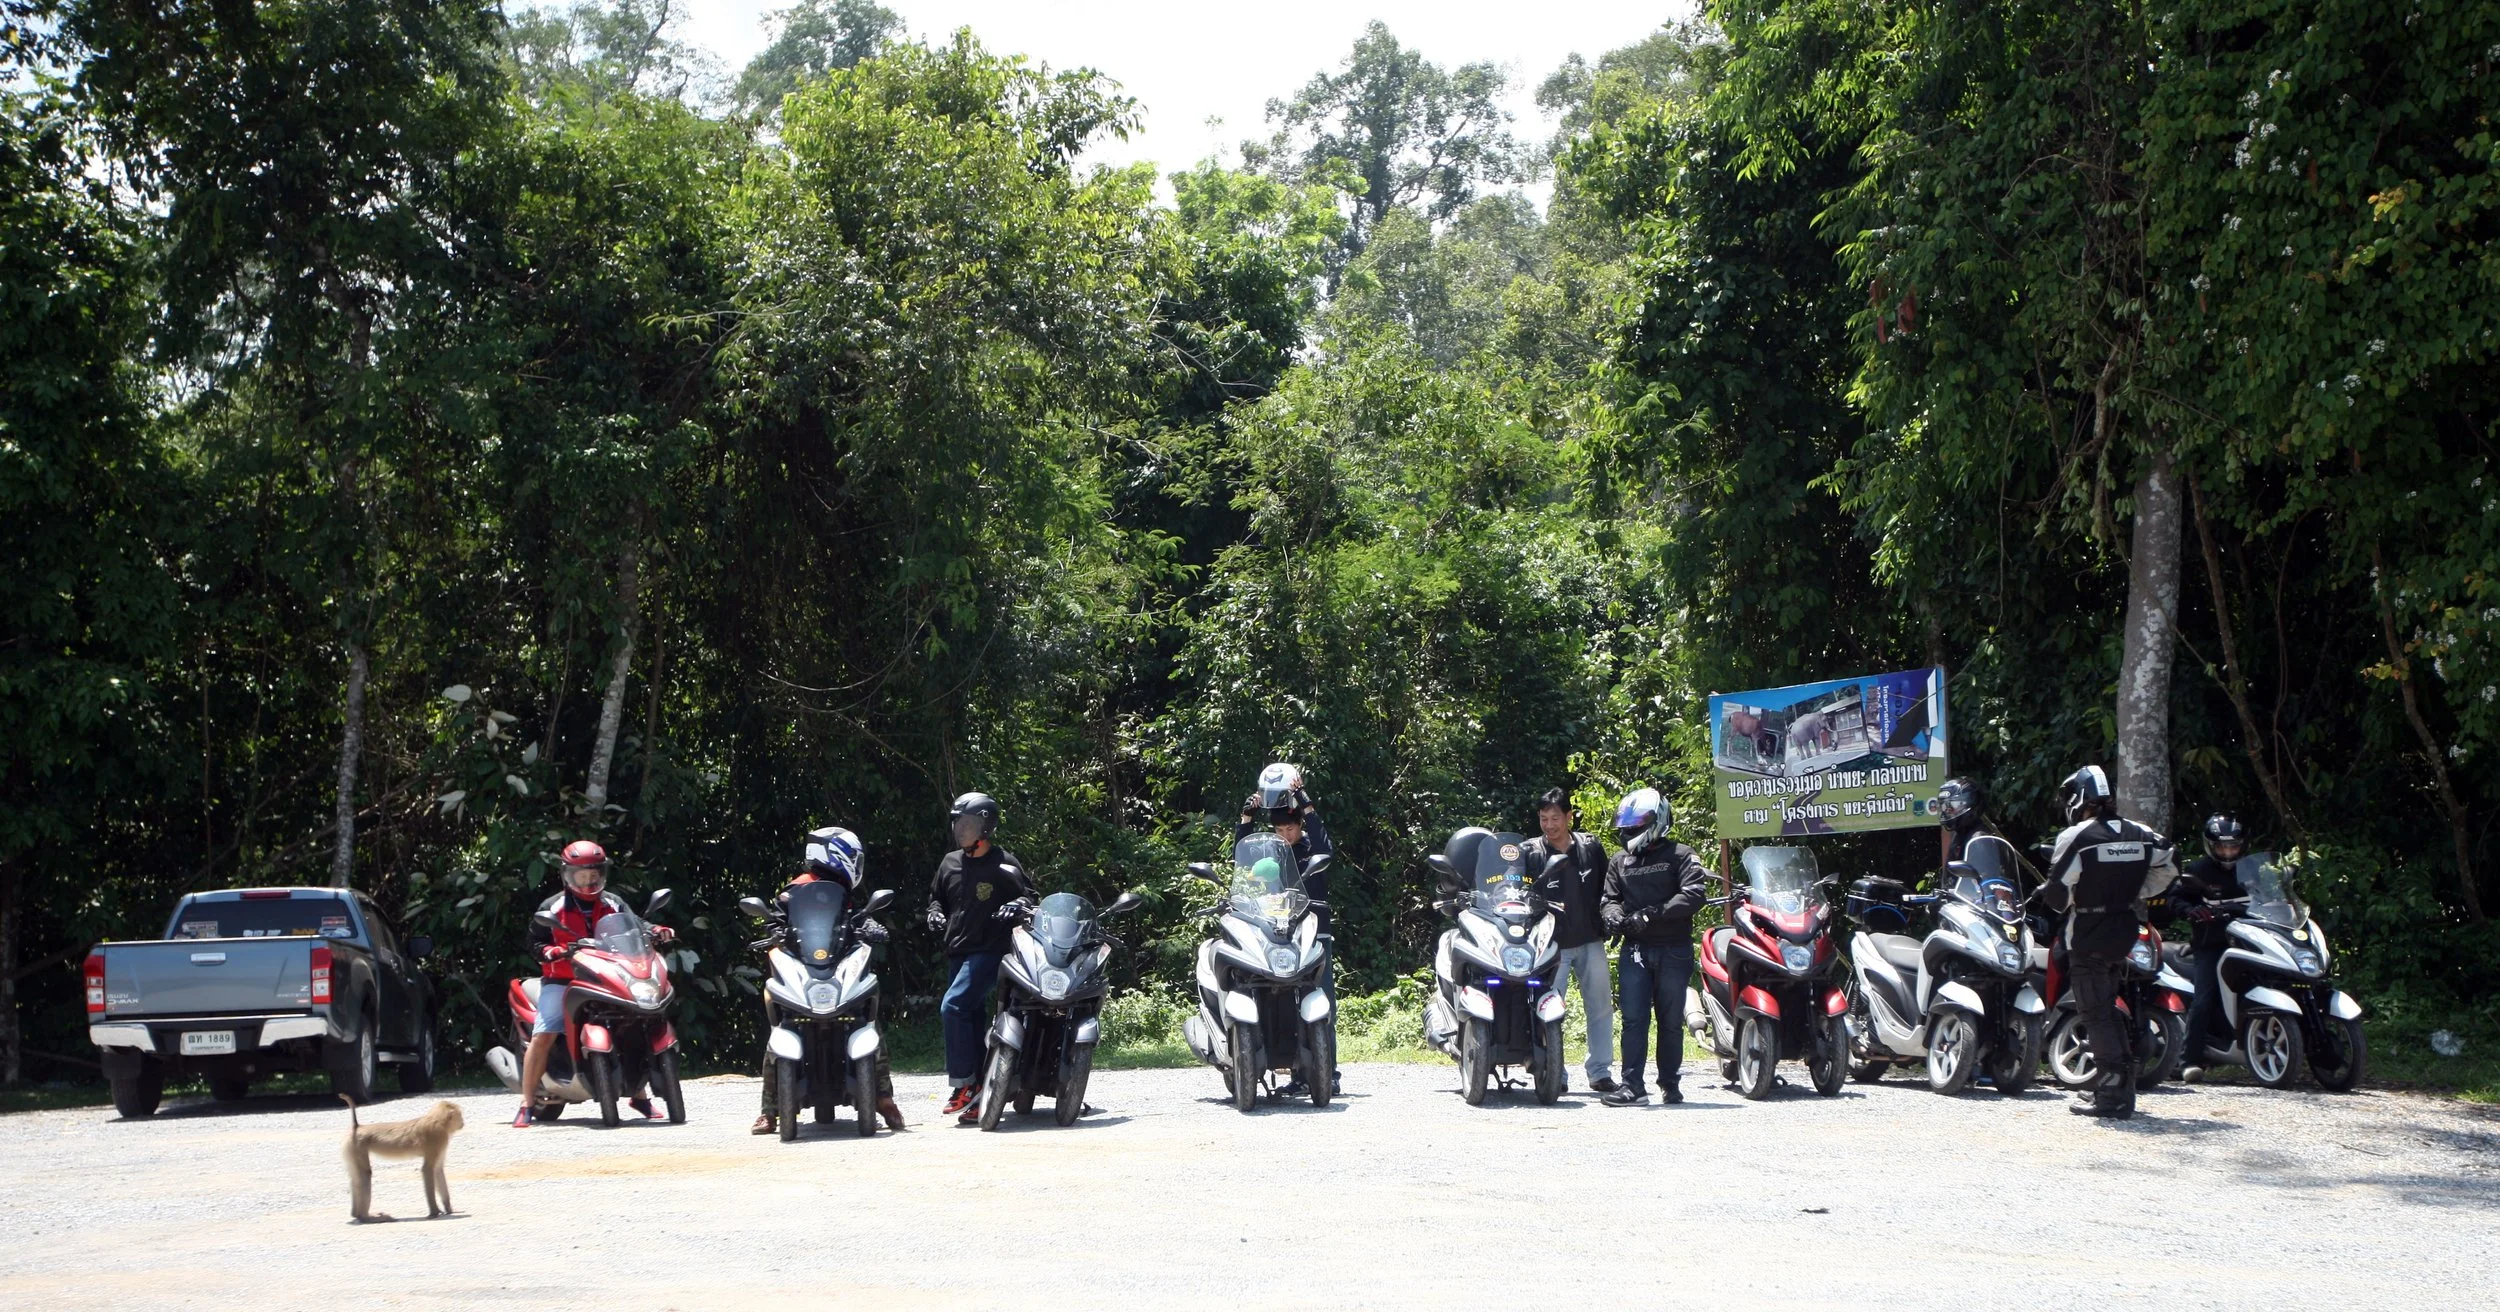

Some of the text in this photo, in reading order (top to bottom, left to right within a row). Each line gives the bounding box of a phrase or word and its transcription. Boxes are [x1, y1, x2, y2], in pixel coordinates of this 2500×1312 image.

[1828, 763, 1866, 790] นำขยะ
[1744, 807, 1769, 825] ตาม
[209, 1033, 230, 1043] 1889
